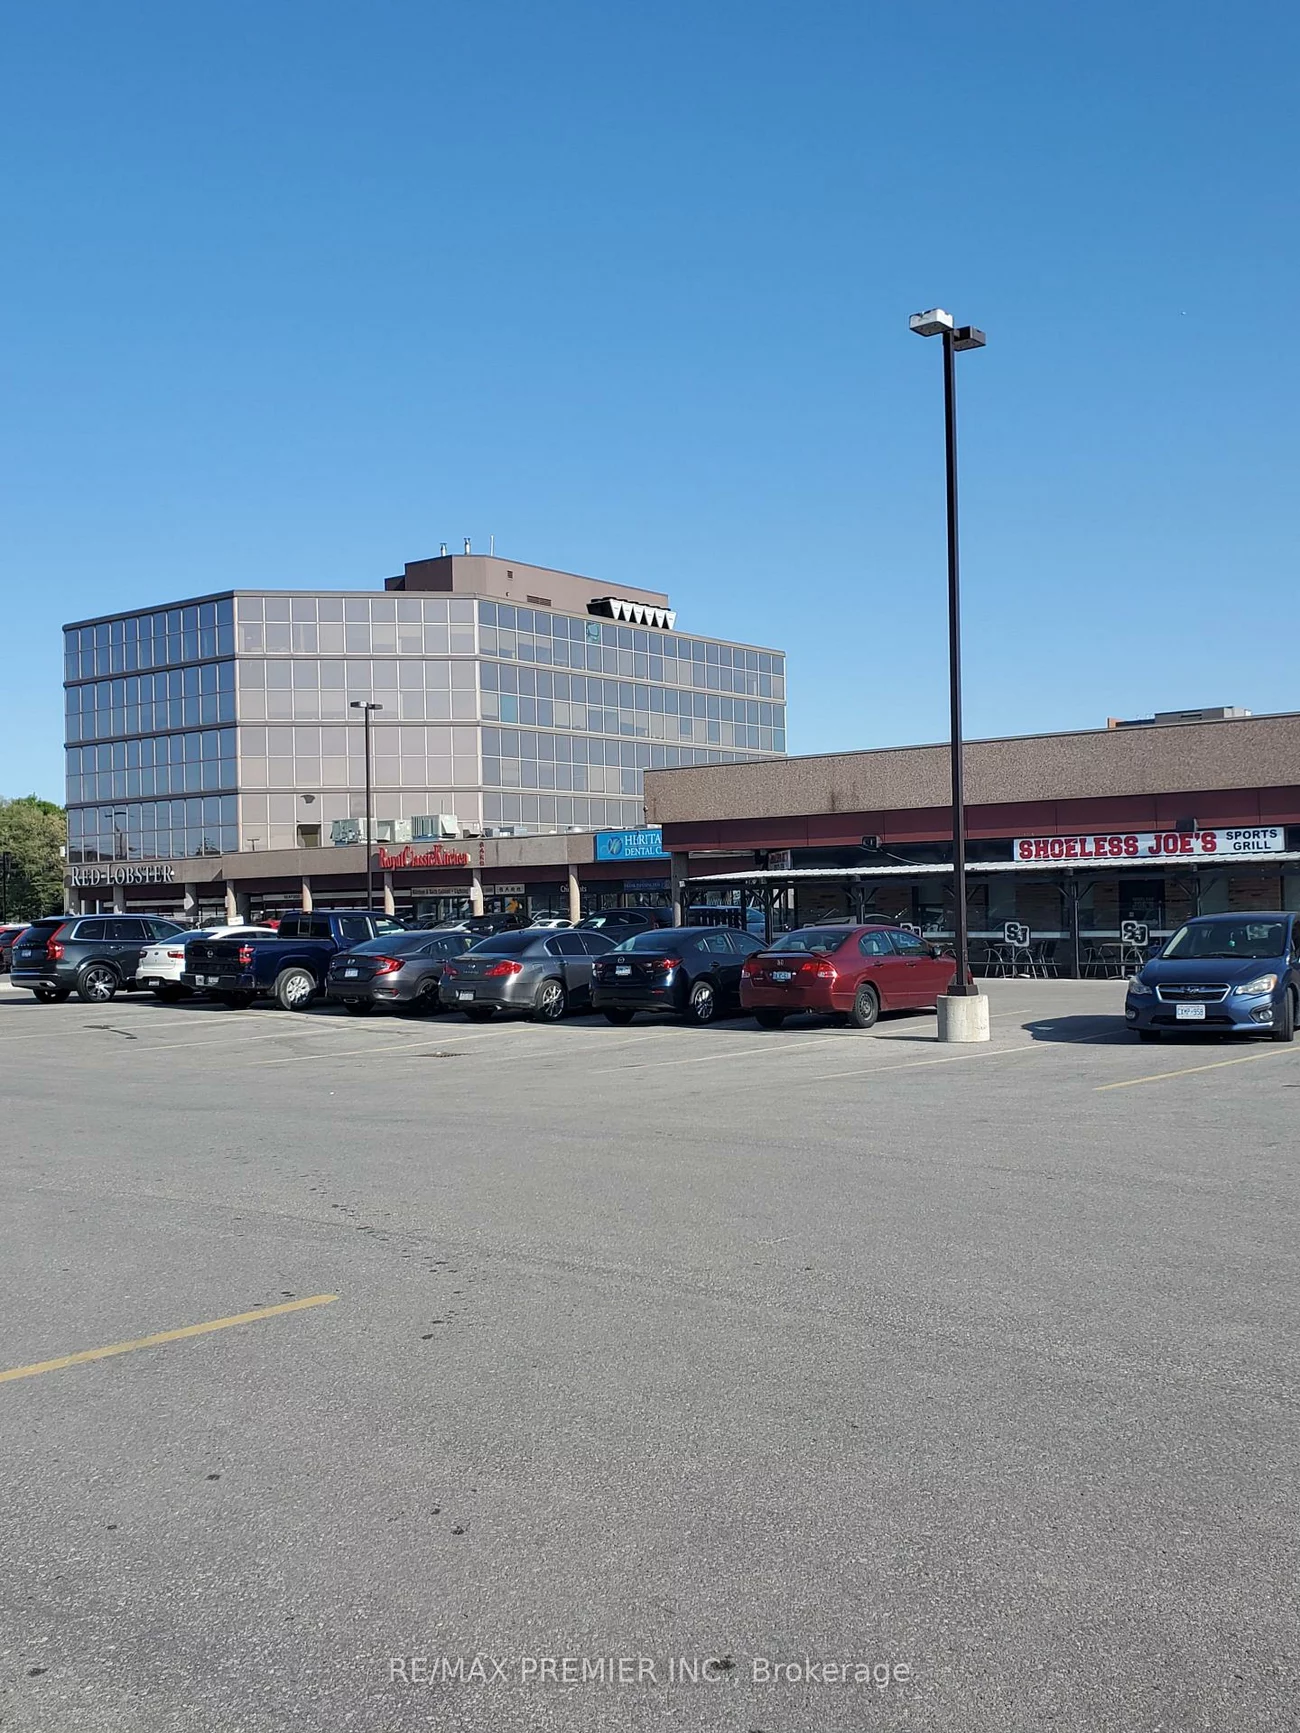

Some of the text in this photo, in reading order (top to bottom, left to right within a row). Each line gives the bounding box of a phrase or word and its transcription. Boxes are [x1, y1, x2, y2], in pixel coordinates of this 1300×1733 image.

[624, 833, 662, 846] HERITA
[1226, 829, 1278, 841] SPORTS
[625, 847, 655, 857] DENTAL
[1018, 831, 1217, 860] SHOELESS JOE'S
[1233, 840, 1272, 851] GRILL
[433, 844, 469, 866] Kitchen
[71, 864, 173, 887] RED LOBSTER
